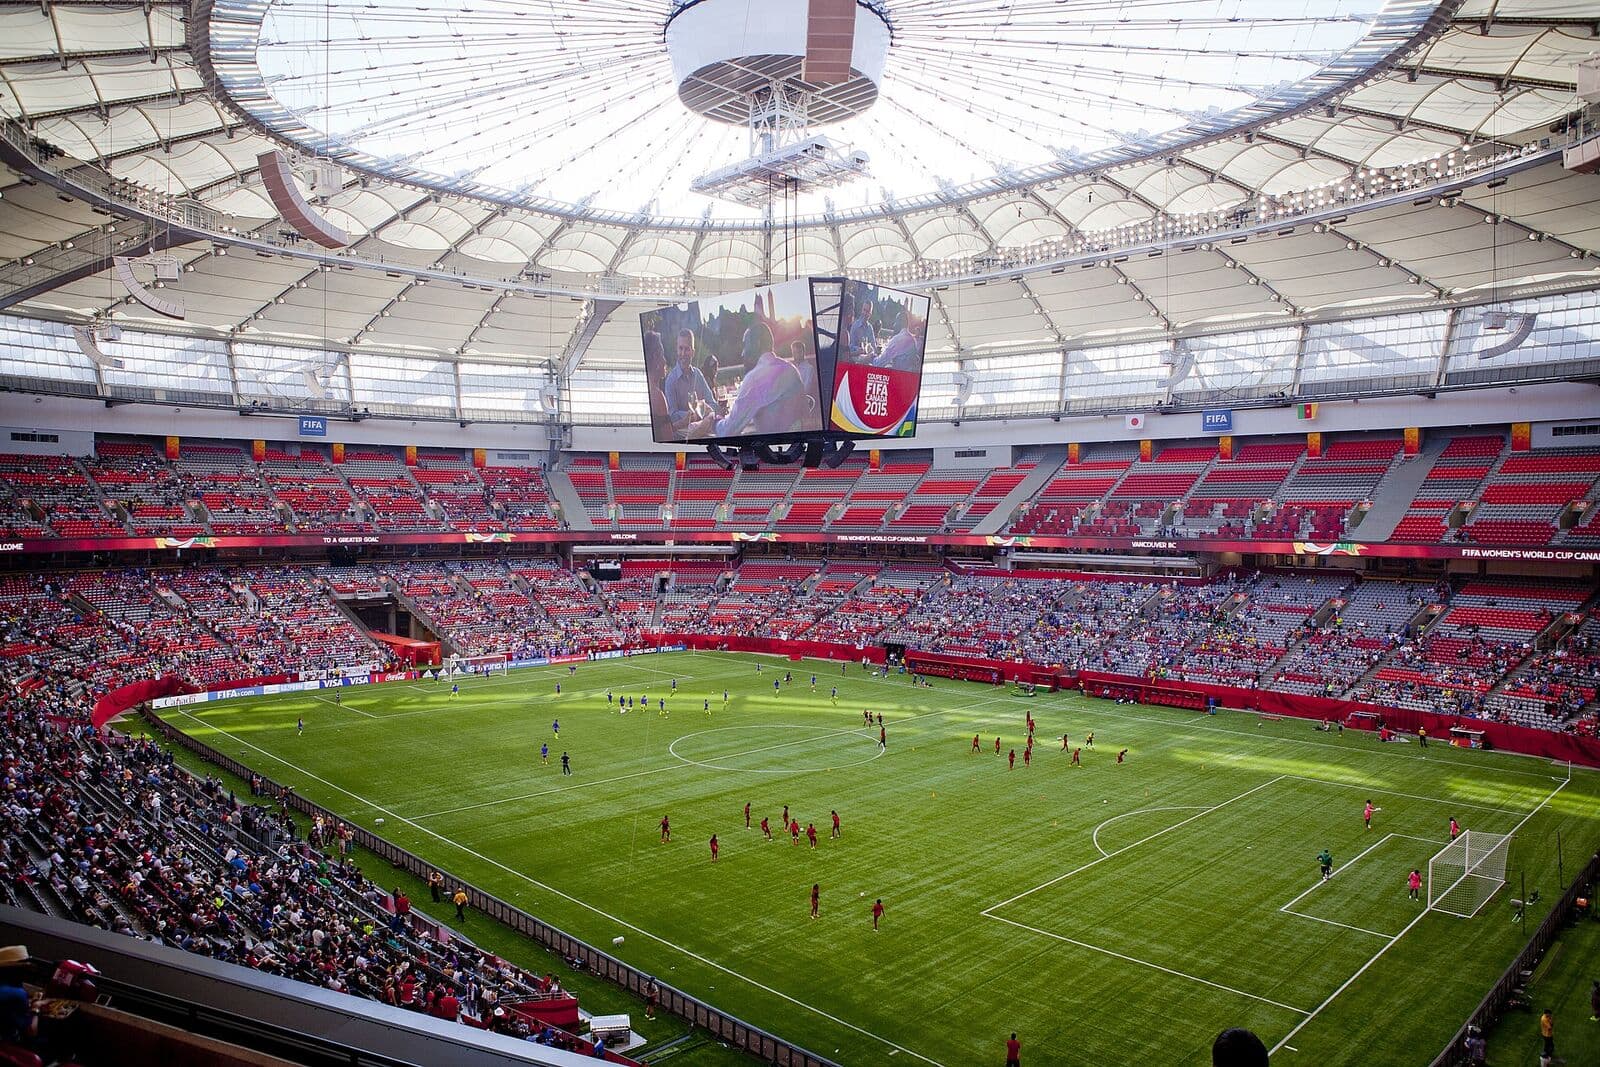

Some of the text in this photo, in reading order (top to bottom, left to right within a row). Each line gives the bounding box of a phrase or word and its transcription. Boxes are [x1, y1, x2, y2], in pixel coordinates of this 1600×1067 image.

[866, 383, 888, 396] FIFA
[865, 394, 887, 402] CANADA
[864, 401, 887, 416] 2015
[1206, 414, 1228, 423] FIFA
[303, 420, 323, 429] FIFA
[1132, 541, 1167, 549] VANCOUVER
[1462, 549, 1481, 557] FIFA
[1481, 549, 1522, 558] WOMEN'S
[1522, 550, 1554, 559] WORLD
[1555, 551, 1573, 559] CUP
[323, 679, 343, 688] VISA
[350, 676, 369, 686] VISA
